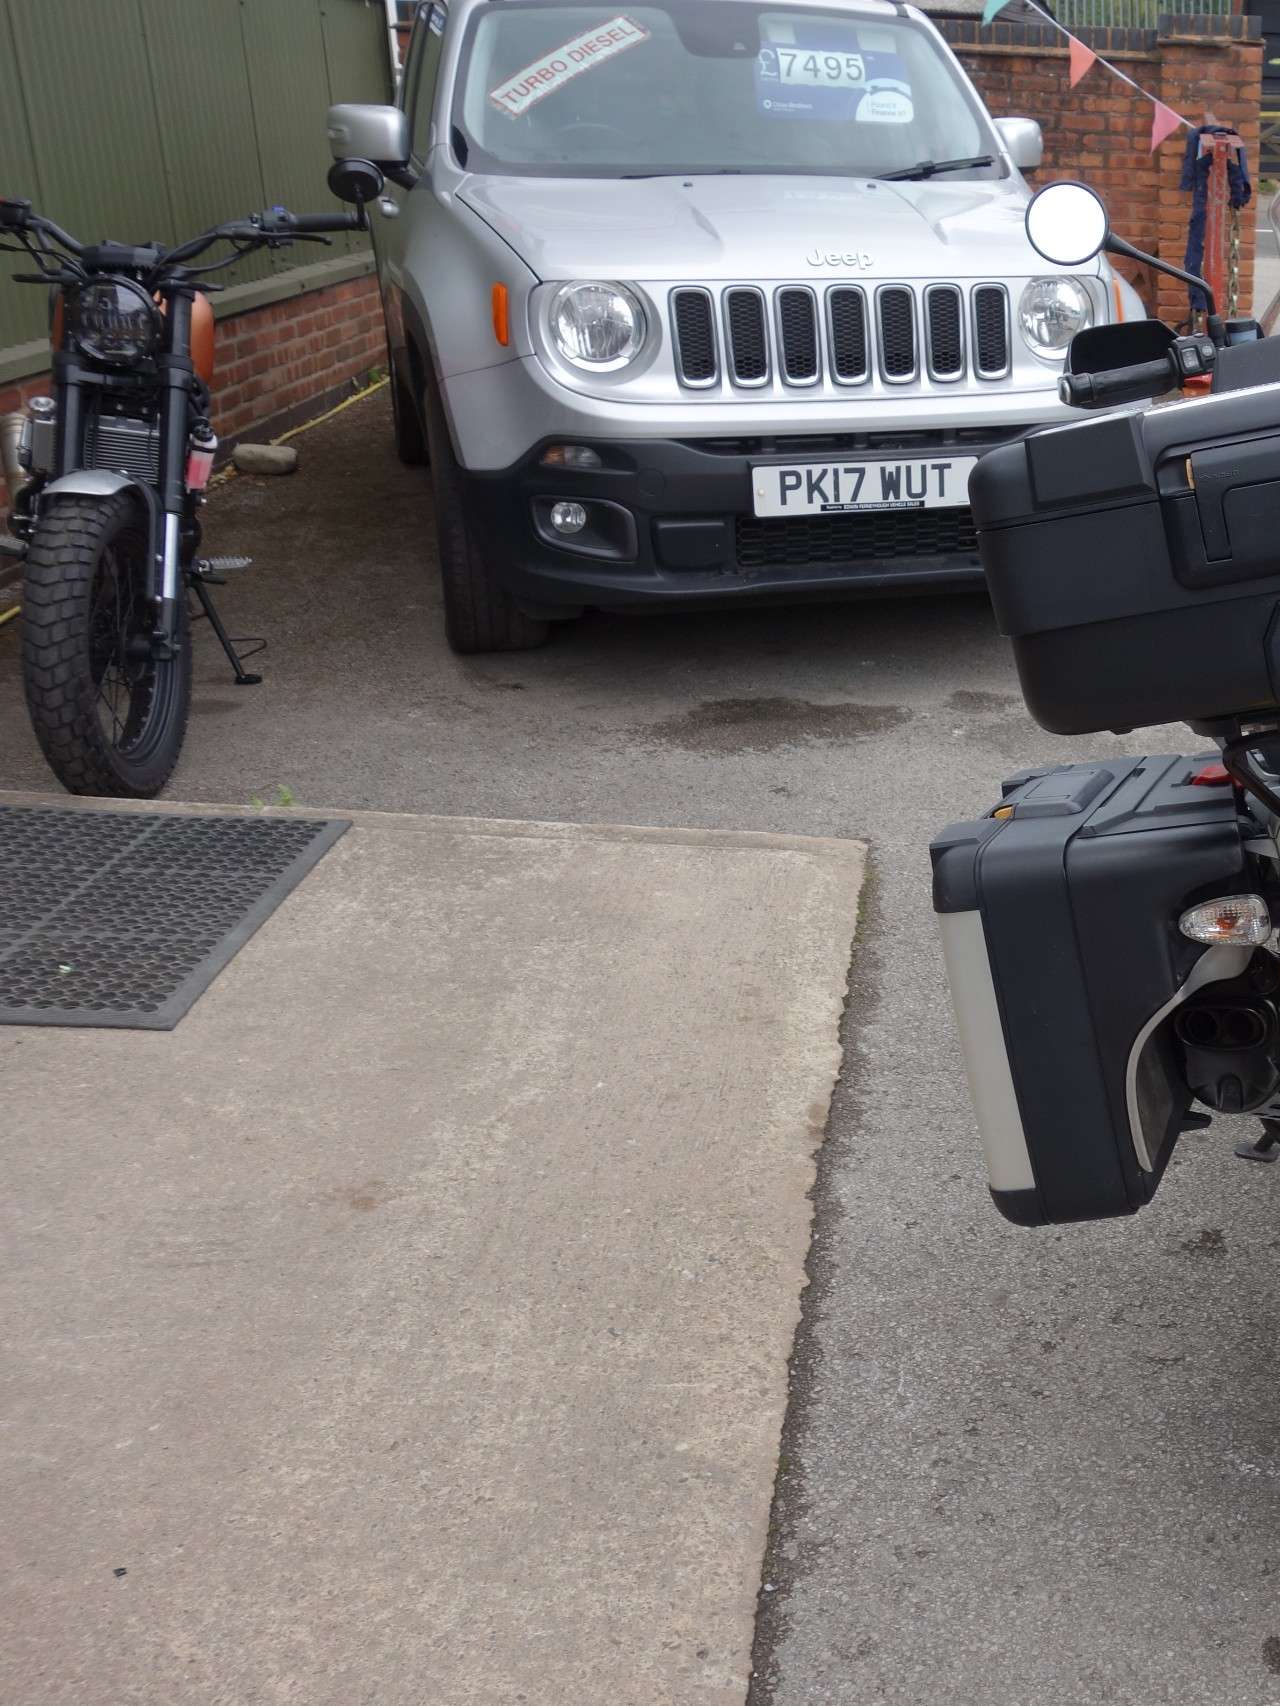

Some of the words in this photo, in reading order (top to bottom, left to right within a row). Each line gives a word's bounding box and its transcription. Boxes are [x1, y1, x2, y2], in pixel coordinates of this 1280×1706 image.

[502, 60, 567, 103] TURBO
[567, 26, 636, 63] DIESEL
[806, 247, 873, 270] Jeep
[779, 467, 866, 506] PK17
[880, 463, 952, 501] WUT
